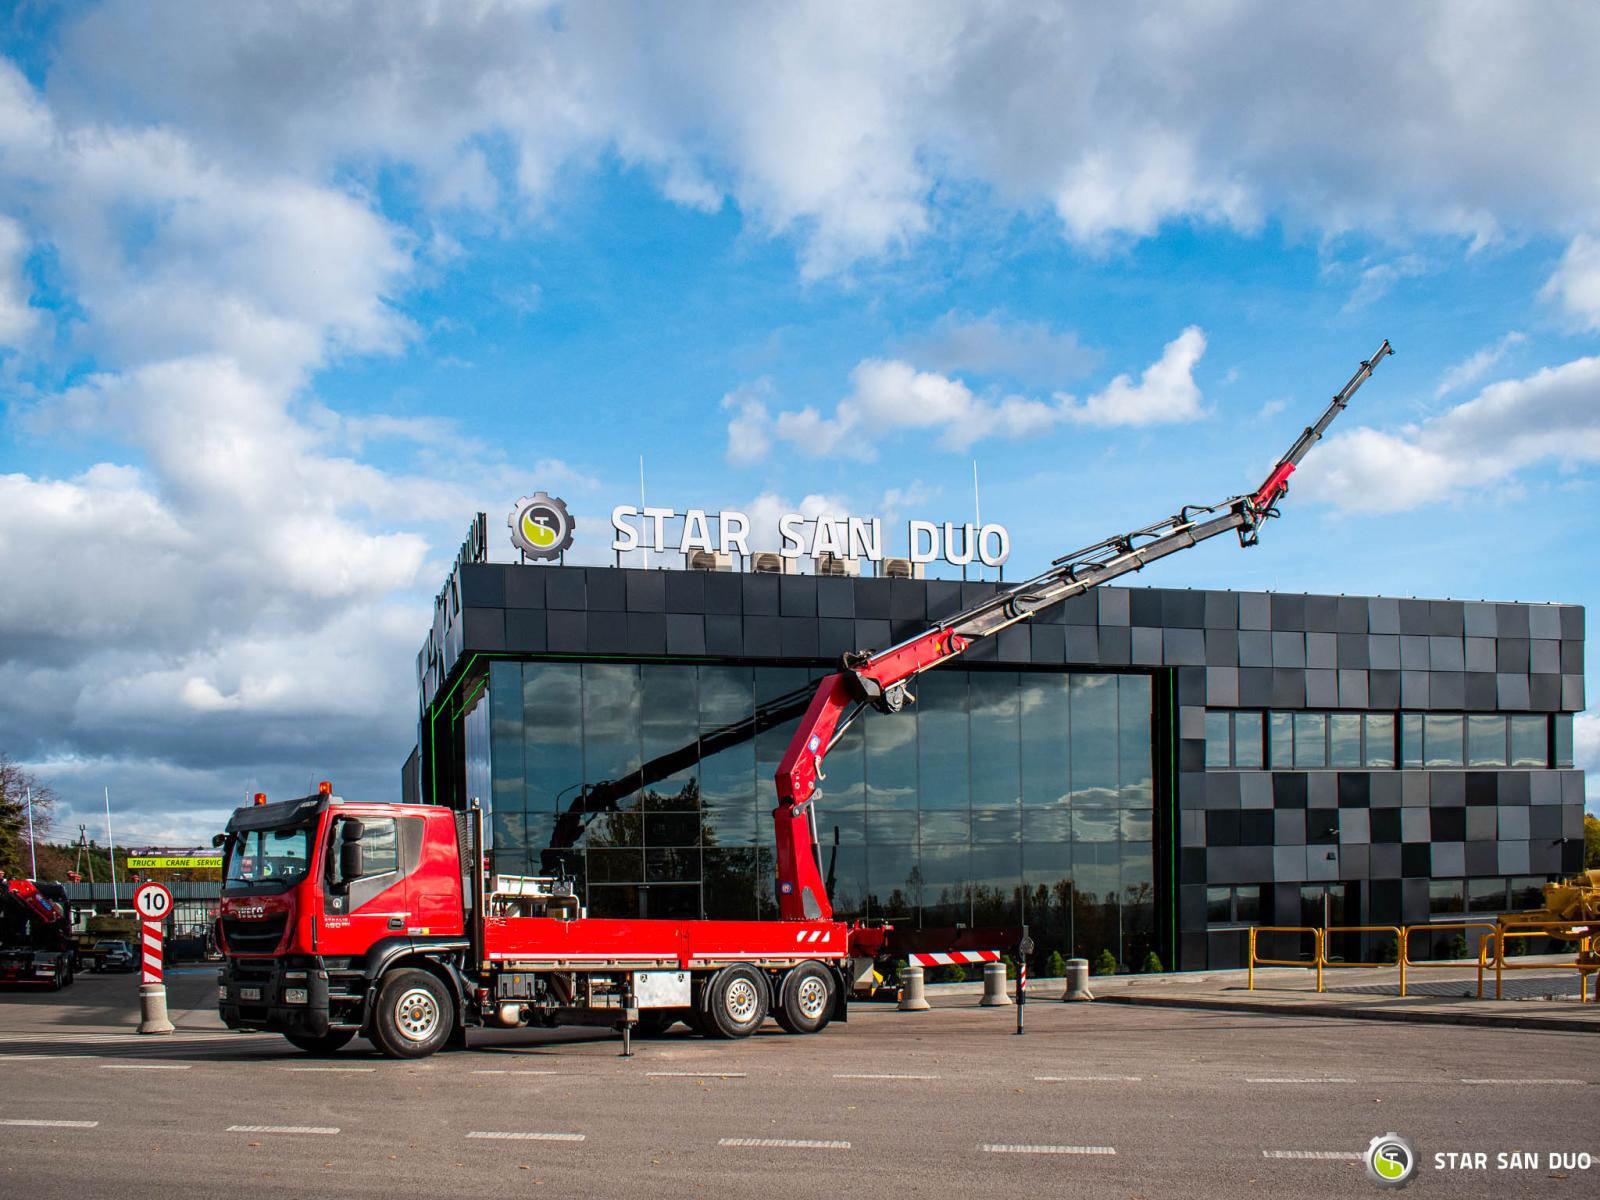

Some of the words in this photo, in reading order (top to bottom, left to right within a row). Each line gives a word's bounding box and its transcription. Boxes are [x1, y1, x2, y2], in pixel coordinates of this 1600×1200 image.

[611, 505, 750, 556] STAR
[779, 513, 882, 561] SAN
[909, 520, 1010, 567] DUO
[144, 892, 165, 910] 10
[238, 906, 263, 918] IVECO
